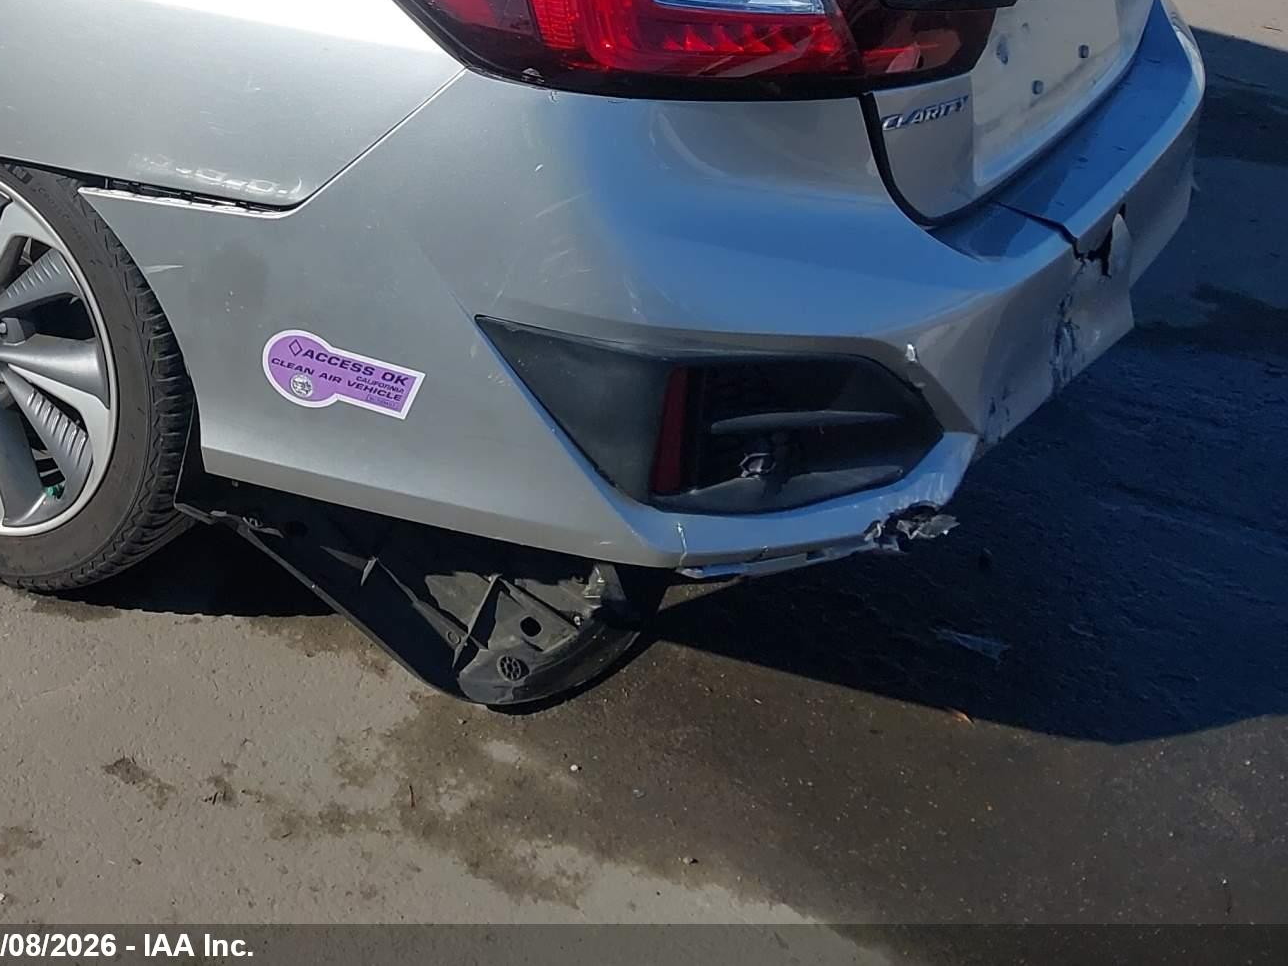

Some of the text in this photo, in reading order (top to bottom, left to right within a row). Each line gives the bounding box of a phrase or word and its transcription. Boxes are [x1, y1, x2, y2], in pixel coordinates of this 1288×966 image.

[882, 95, 968, 131] CLARITY
[271, 357, 315, 376] CLEAN
[318, 372, 342, 384] AIR
[347, 380, 405, 402] VEHICLE
[302, 349, 409, 387] ACCESS OK
[356, 375, 405, 395] CALIFORNIA
